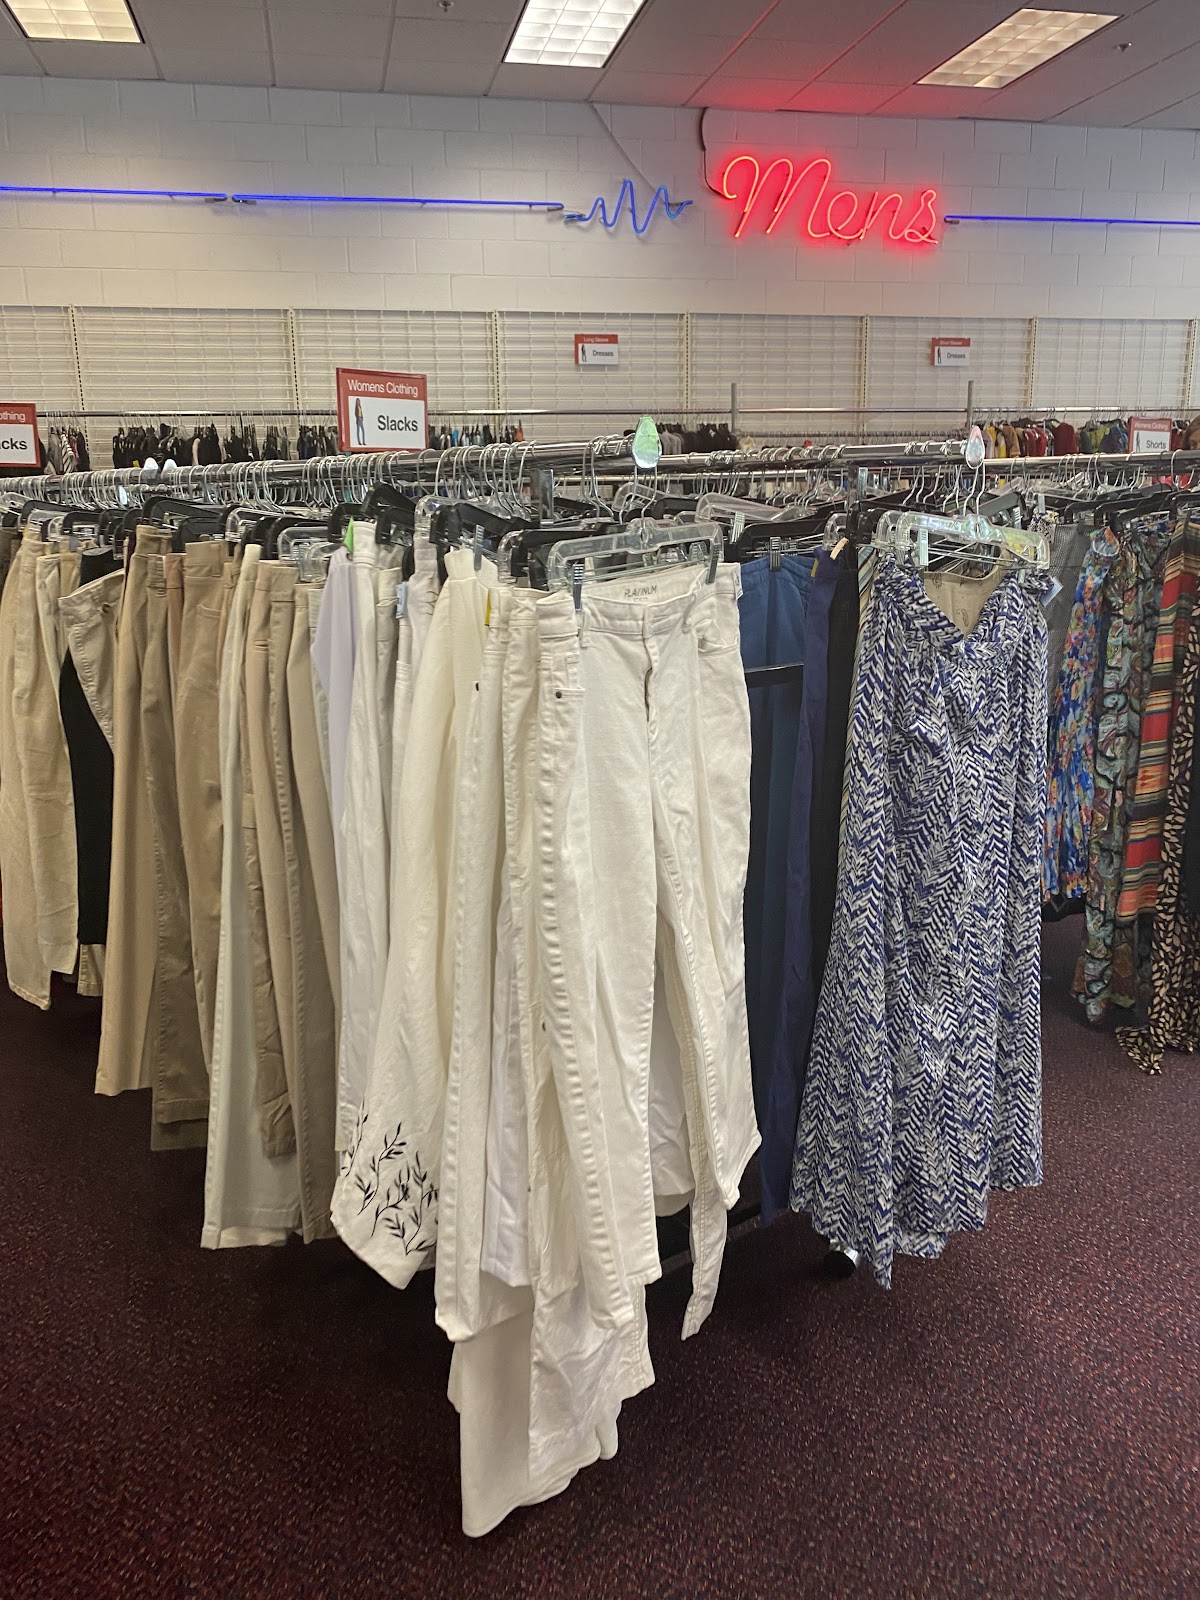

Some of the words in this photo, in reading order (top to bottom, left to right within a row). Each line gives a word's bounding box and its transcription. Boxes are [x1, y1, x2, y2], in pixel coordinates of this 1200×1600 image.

[723, 155, 939, 245] Mens
[592, 349, 614, 357] Dresses
[347, 378, 385, 393] Womens
[386, 381, 419, 398] Clothing
[377, 414, 419, 432] Slacks
[0, 437, 28, 450] cks
[1146, 439, 1167, 450] Shorts
[624, 584, 658, 598] PLATINUM
